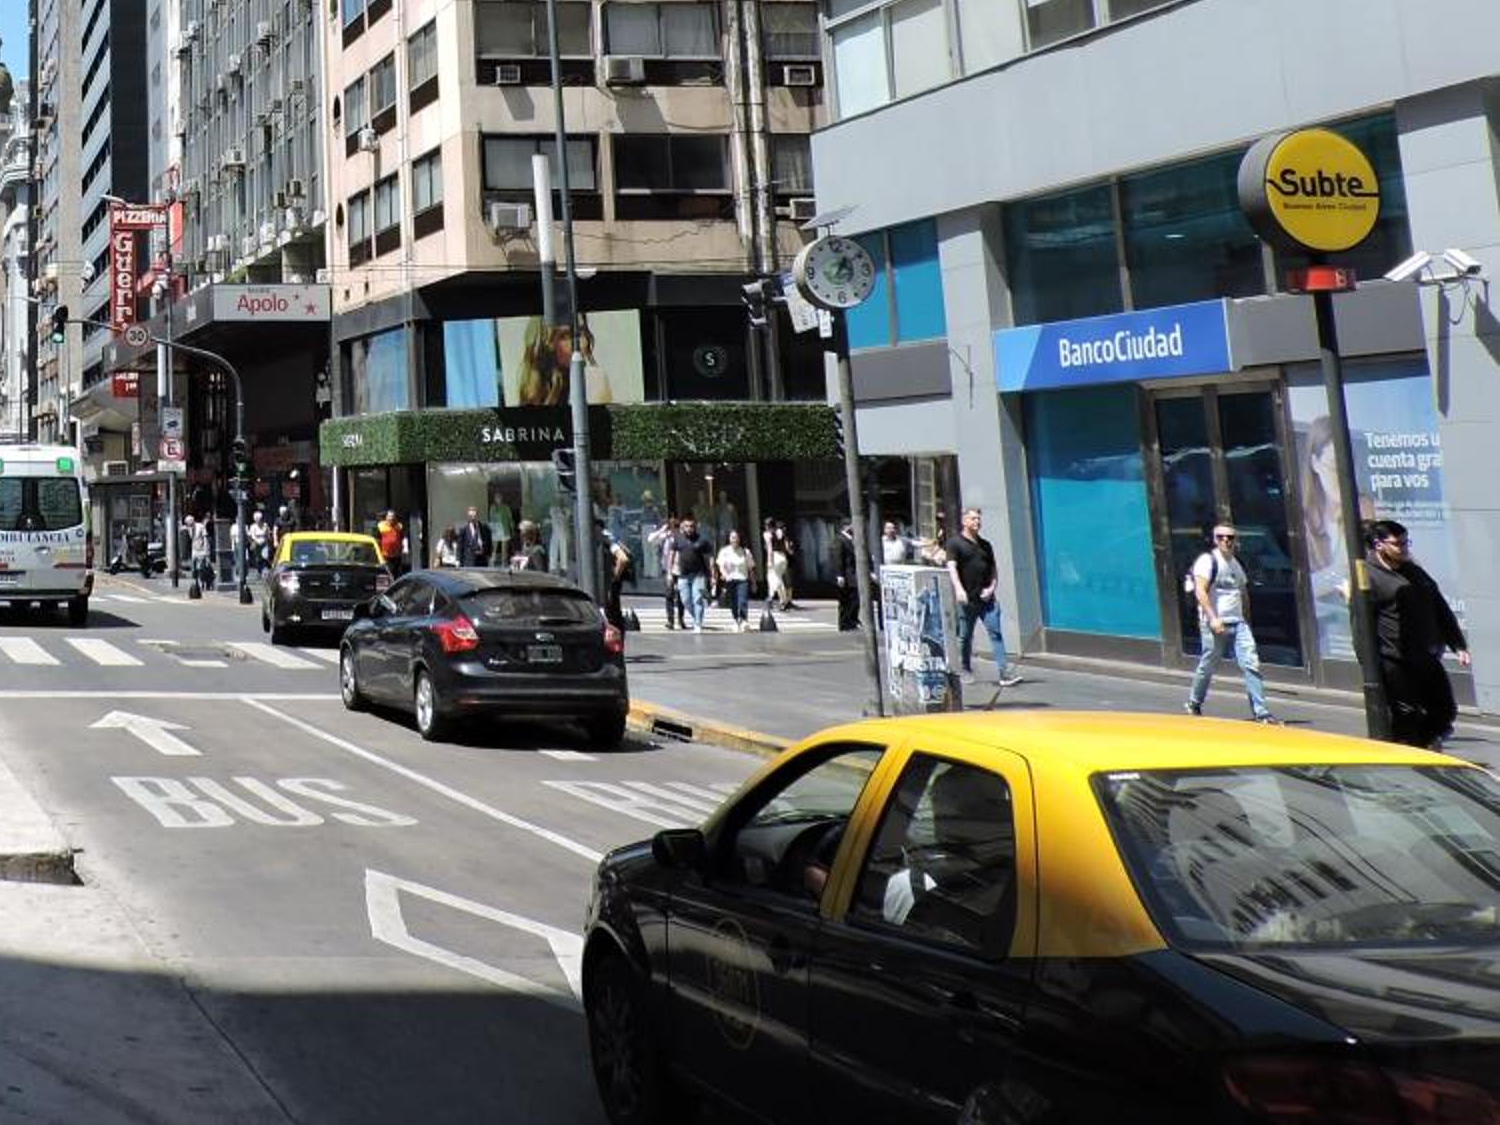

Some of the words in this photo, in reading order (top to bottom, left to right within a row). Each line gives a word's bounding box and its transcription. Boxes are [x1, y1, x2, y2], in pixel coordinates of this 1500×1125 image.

[1268, 169, 1380, 197] Subte
[113, 210, 166, 224] PIZZERIA
[115, 231, 133, 330] Guerr
[237, 293, 289, 315] Apolo
[129, 330, 145, 343] 30
[1059, 324, 1182, 368] BancoCiudad
[481, 428, 565, 443] SABRINA
[1365, 432, 1429, 449] Tenemos
[1368, 451, 1415, 468] cuenta
[1371, 473, 1402, 491] para
[1403, 474, 1429, 488] vos
[111, 777, 419, 828] BUS
